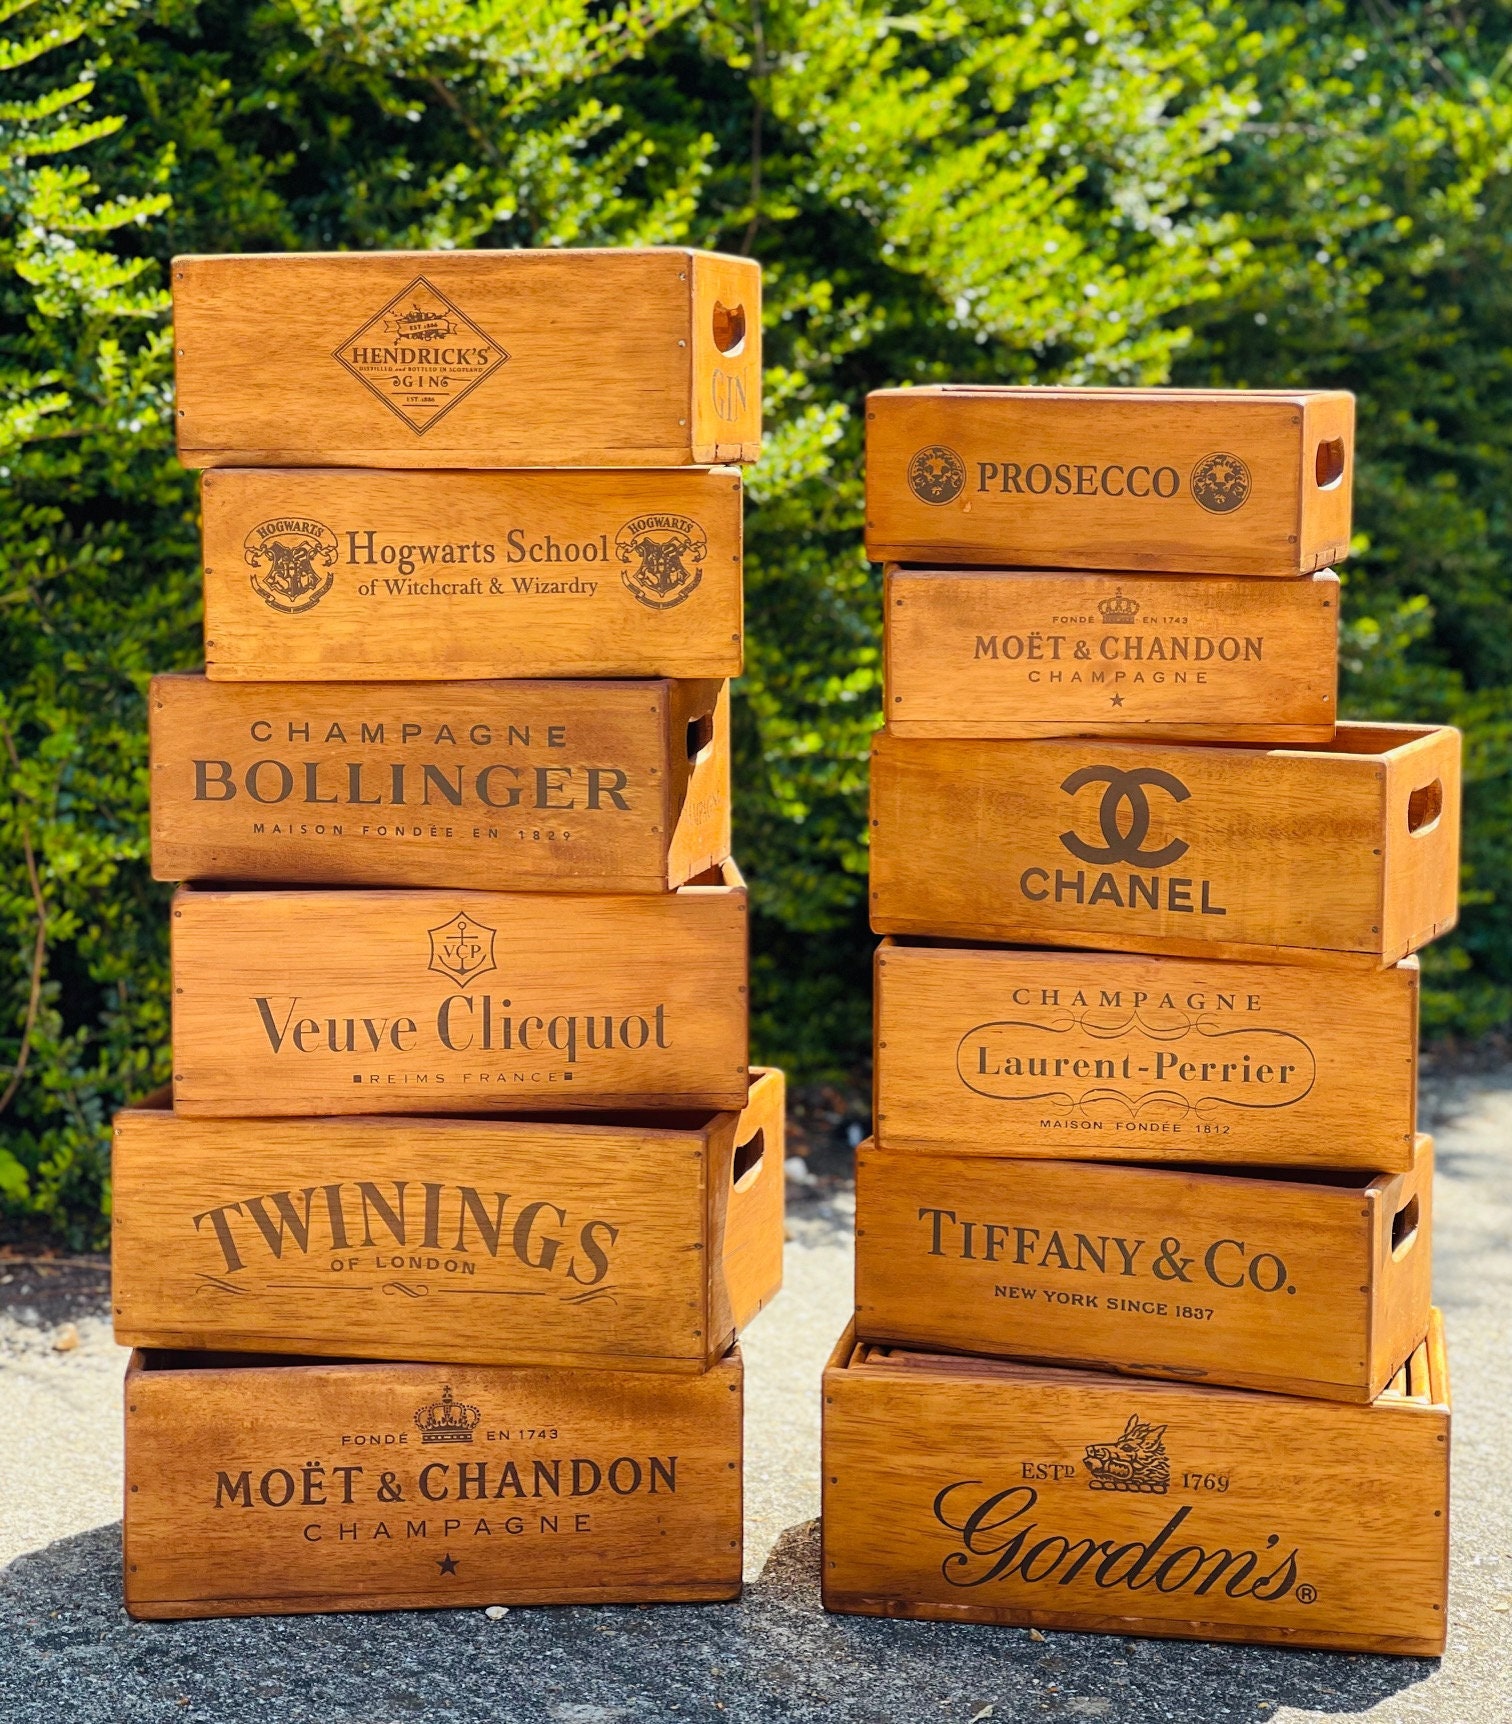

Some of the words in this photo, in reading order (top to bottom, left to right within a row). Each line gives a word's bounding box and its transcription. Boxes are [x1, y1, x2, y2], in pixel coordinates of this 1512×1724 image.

[352, 347, 489, 365] HENDRICK'S
[402, 375, 440, 388] GIN
[712, 366, 748, 422] GIN
[976, 461, 1181, 499] PROSECCO
[256, 520, 325, 539] HOGWARTS
[627, 516, 694, 535] HOGWARTS
[345, 530, 495, 576] Hogwarts
[507, 528, 611, 564] School
[358, 578, 378, 596] of
[382, 577, 483, 596] Witchcraft
[489, 577, 504, 595] &
[511, 576, 599, 597] Wizardry
[1142, 616, 1158, 624] EN
[1163, 616, 1189, 624] 1743
[973, 631, 1066, 660] MOËT
[1073, 639, 1092, 661] &
[1099, 635, 1264, 662] CHANDON
[1028, 670, 1208, 684] CHAMPAGNE
[250, 720, 567, 748] CHAMPAGNE
[191, 759, 633, 811] BOLLINGER
[253, 823, 343, 835] MAISON
[362, 824, 453, 838] FONDÉE
[473, 828, 498, 838] EN
[518, 830, 571, 841] 1829
[1019, 866, 1227, 916] CHANEL
[443, 944, 482, 960] VCP
[1011, 987, 1262, 1012] CHAMPAGNE
[248, 996, 418, 1055] Veuve
[437, 994, 674, 1063] Clicquot
[369, 1073, 445, 1084] REIMS
[463, 1072, 557, 1083] FRANCE
[975, 1046, 1296, 1085] Laurent-Perrier
[1040, 1119, 1103, 1130] MAISON
[1116, 1120, 1182, 1133] FONDÉE
[1195, 1124, 1231, 1135] 1812
[193, 1181, 620, 1286] TWININGS
[918, 1207, 1146, 1277] TIFFANY
[1151, 1236, 1195, 1283] &
[330, 1256, 359, 1273] OF
[375, 1256, 476, 1276] LONDON
[994, 1285, 1036, 1301] NEW
[1043, 1290, 1099, 1309] YORK
[1106, 1297, 1168, 1317] SINCE
[1175, 1304, 1215, 1322] 1837
[341, 1432, 408, 1446] FONDÉ
[486, 1430, 510, 1441] EN
[519, 1428, 559, 1440] 1743
[213, 1460, 364, 1509] MOËT
[376, 1471, 406, 1503] &
[418, 1456, 679, 1502] CHANDON
[1182, 1472, 1230, 1493] 1769
[303, 1514, 592, 1542] CHAMPAGNE
[932, 1479, 1299, 1601] Gordon's
